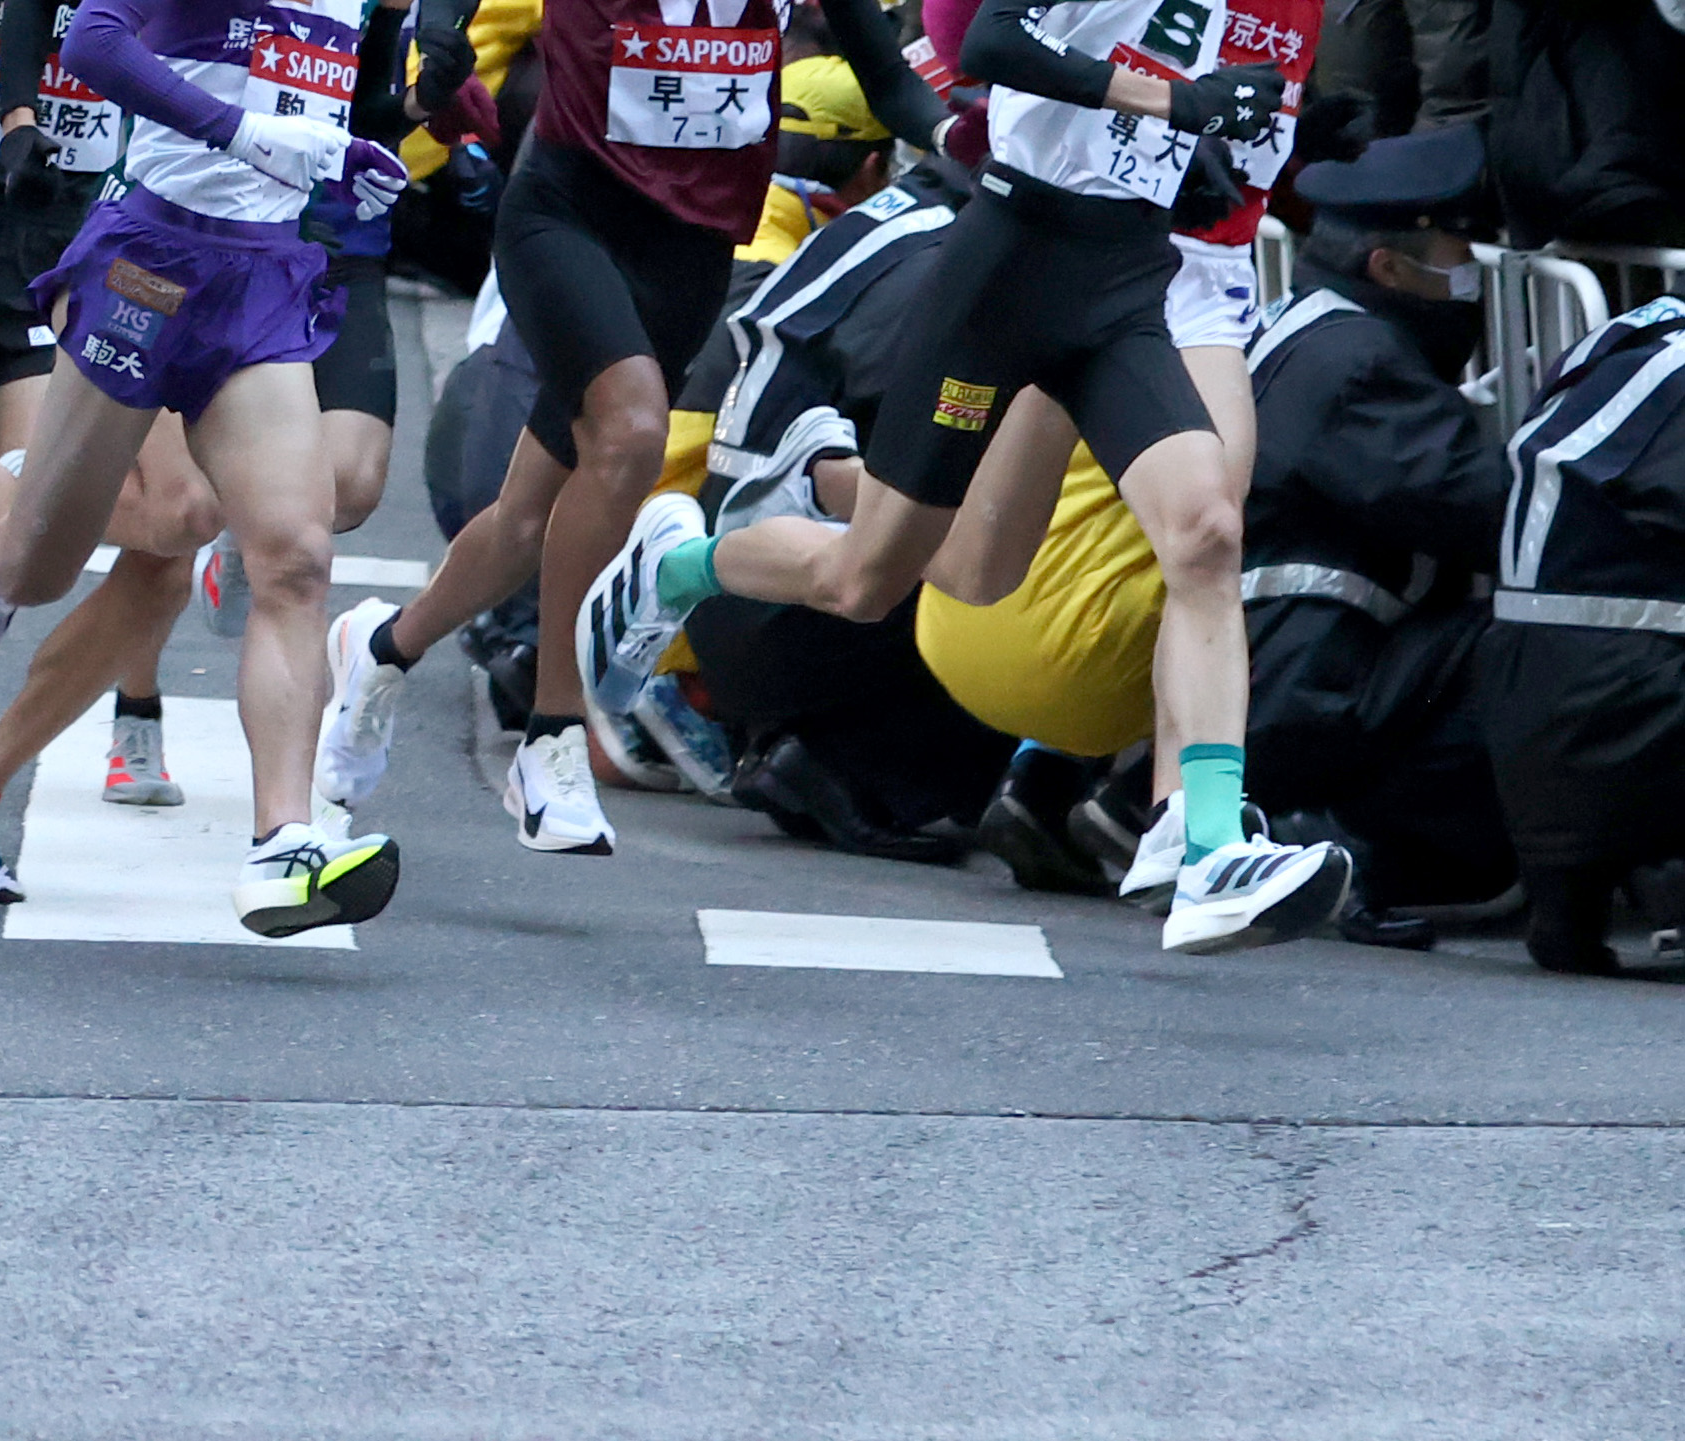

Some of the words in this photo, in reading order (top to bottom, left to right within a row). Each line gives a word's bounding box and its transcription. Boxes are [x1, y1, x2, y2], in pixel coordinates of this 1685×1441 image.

[285, 50, 358, 94] SAPPO
[655, 36, 774, 67] SAPPORO
[647, 75, 750, 115] 早大
[672, 116, 723, 144] 7-1
[1107, 148, 1163, 198] 12-1
[80, 332, 146, 380] 駒大
